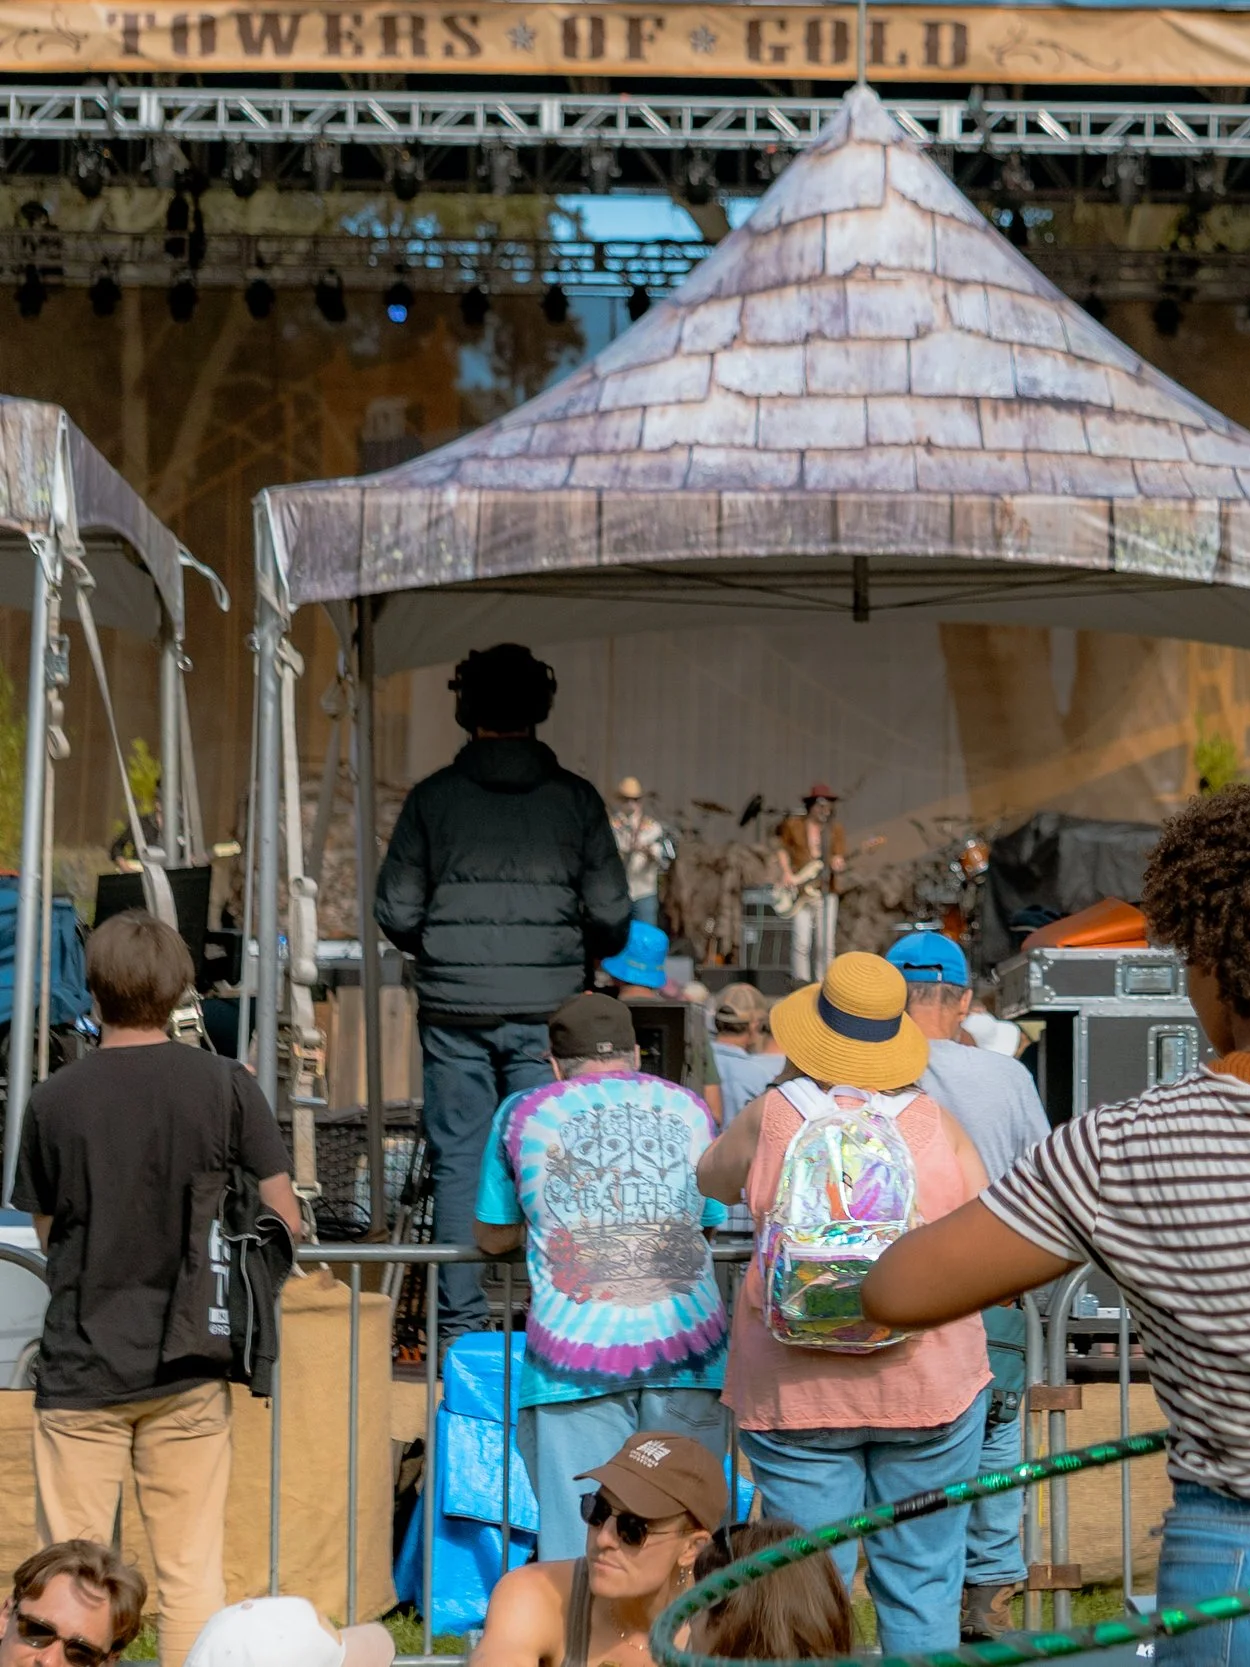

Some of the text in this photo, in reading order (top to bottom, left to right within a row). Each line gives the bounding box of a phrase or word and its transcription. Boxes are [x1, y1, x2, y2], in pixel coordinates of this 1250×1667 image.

[104, 12, 968, 68] TOWERS OF GOLD
